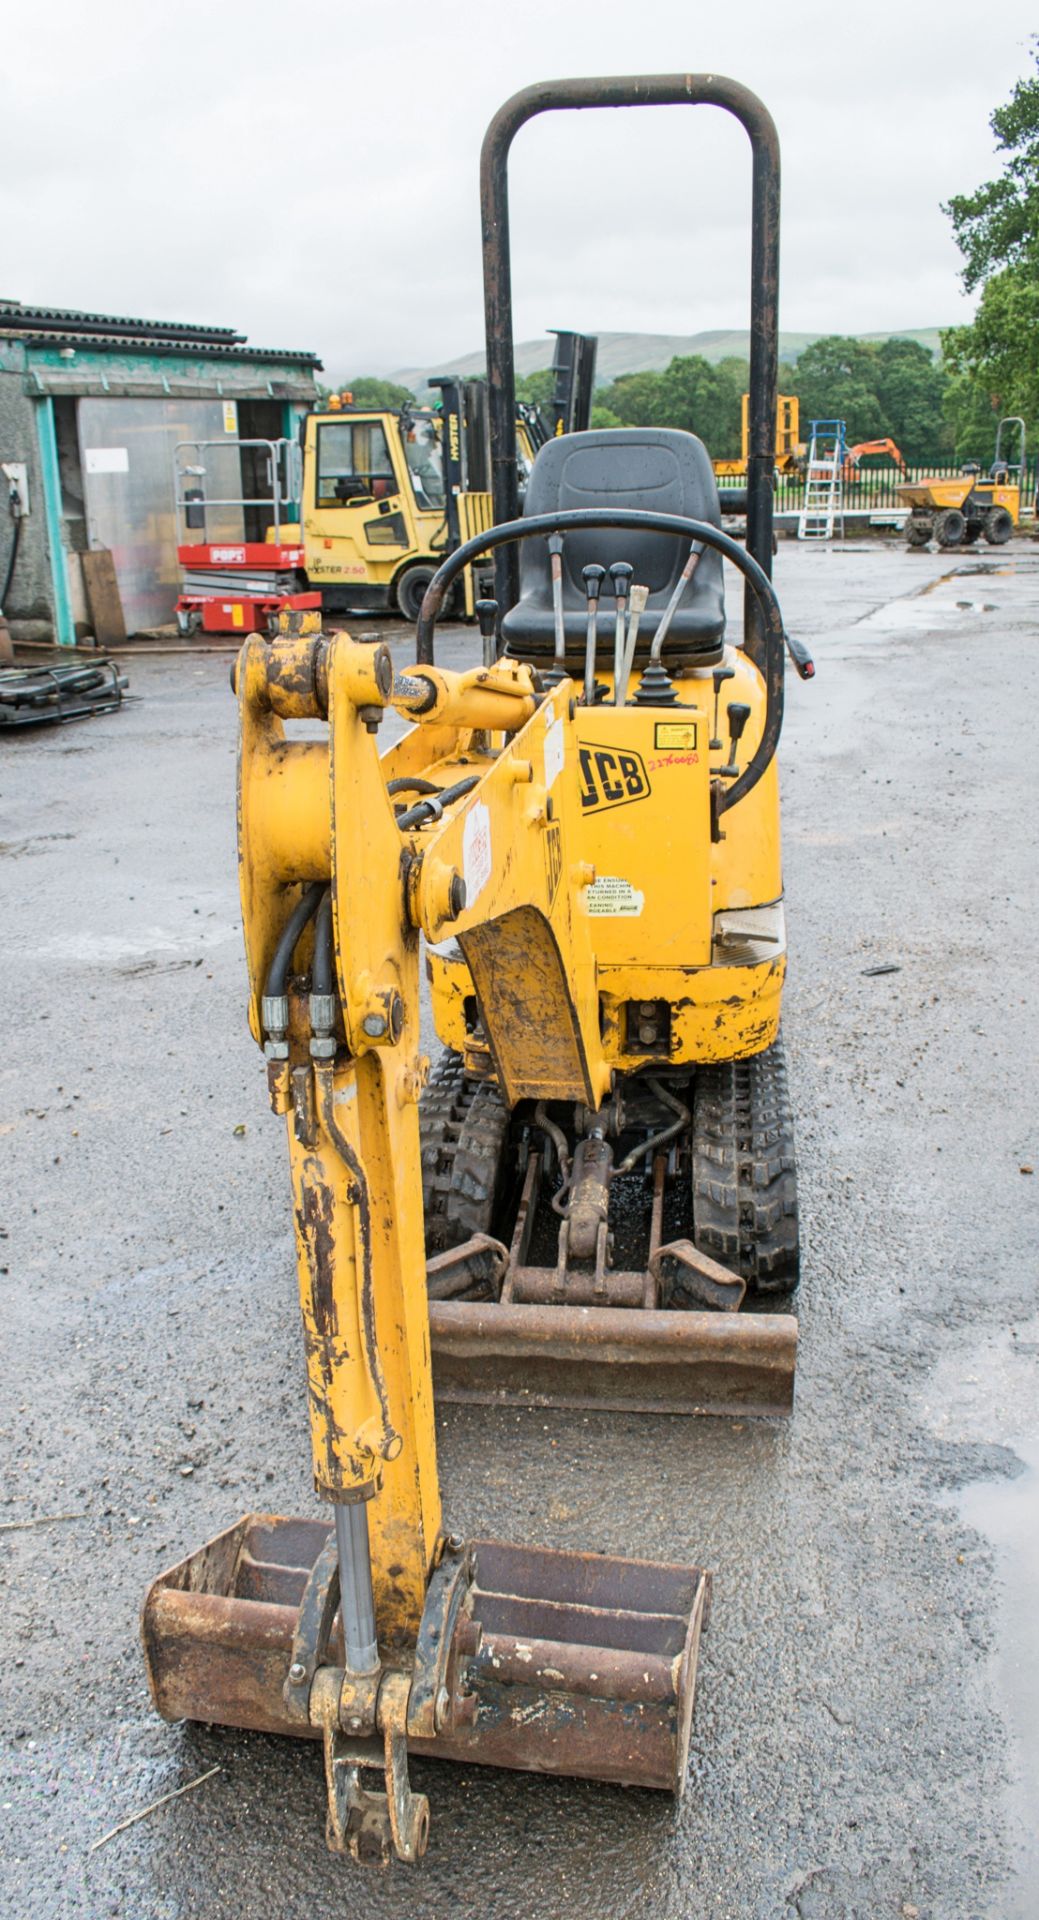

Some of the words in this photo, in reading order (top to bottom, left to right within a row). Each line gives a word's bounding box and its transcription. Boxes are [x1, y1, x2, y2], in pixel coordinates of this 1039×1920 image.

[448, 413, 459, 461] HYSTER
[579, 749, 644, 807] JCB
[546, 826, 562, 906] JCB
